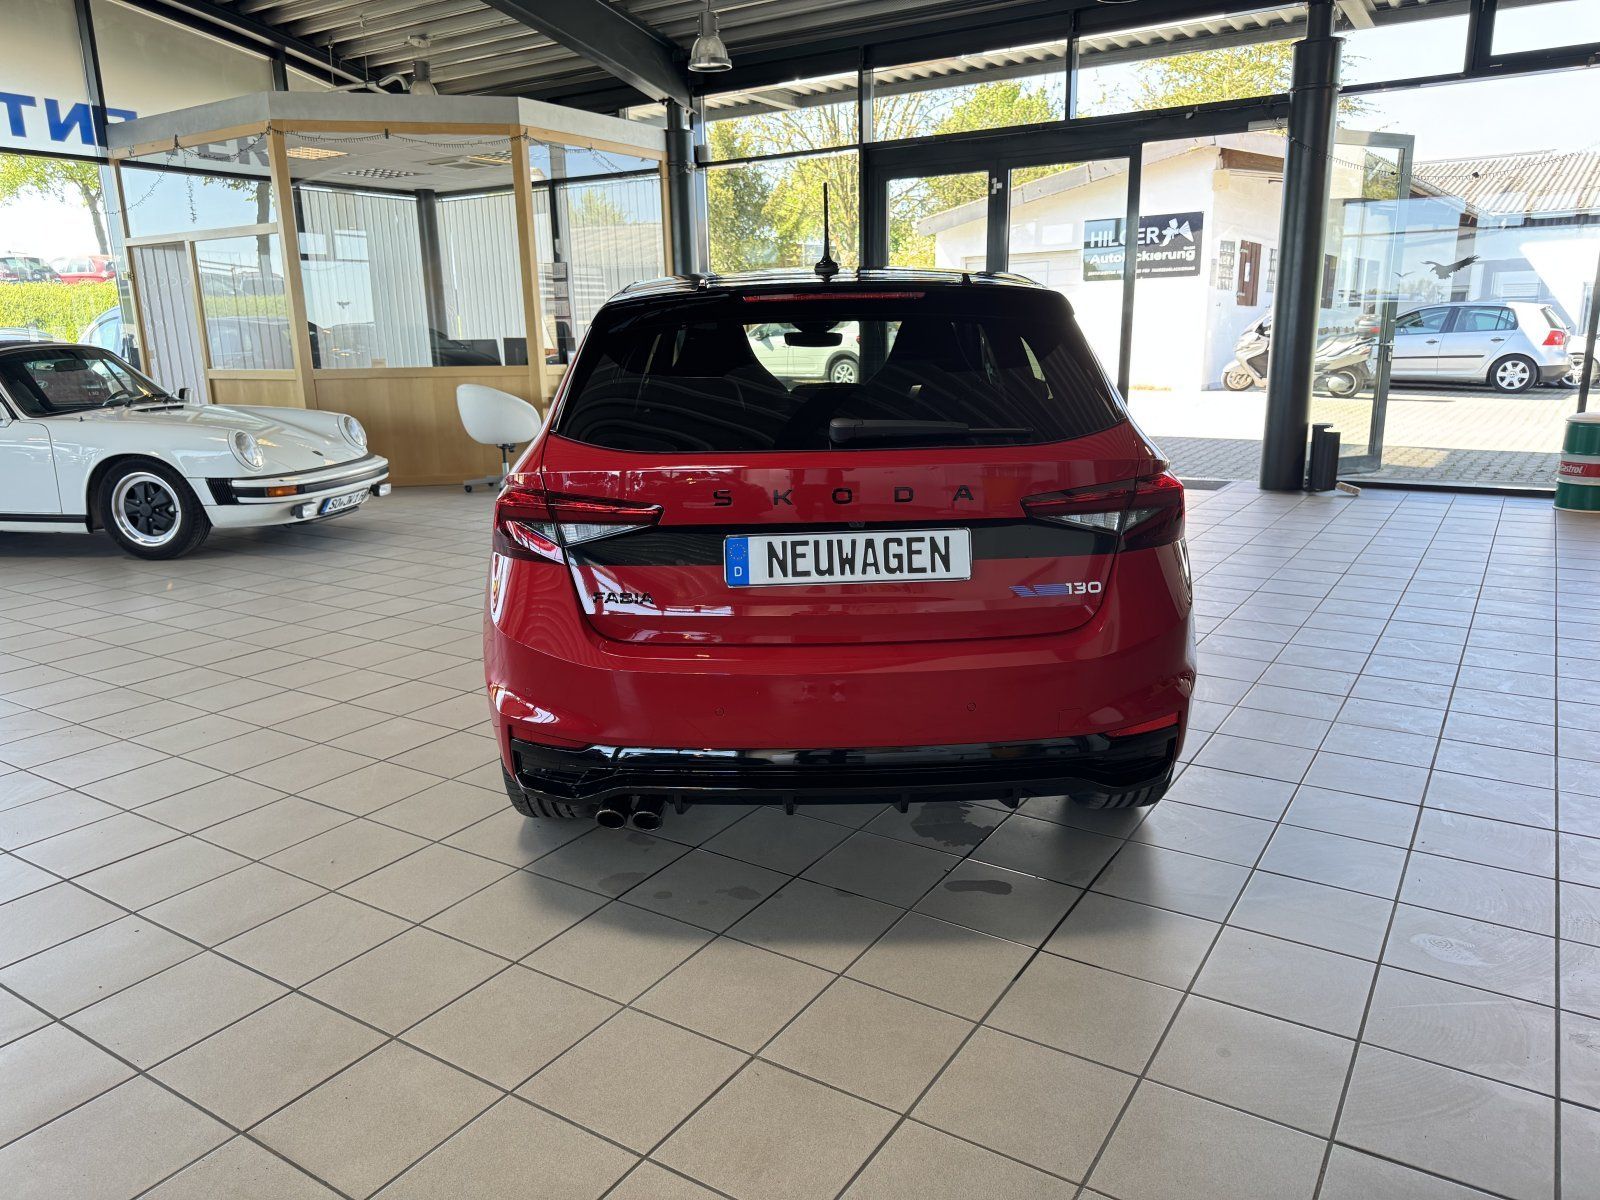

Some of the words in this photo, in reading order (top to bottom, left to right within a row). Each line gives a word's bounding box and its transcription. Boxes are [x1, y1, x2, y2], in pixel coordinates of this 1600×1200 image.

[713, 485, 974, 506] SKODA
[734, 566, 743, 577] D
[767, 536, 951, 578] NEUWAGEN
[1065, 581, 1102, 595] 130
[593, 591, 654, 604] FABIA
